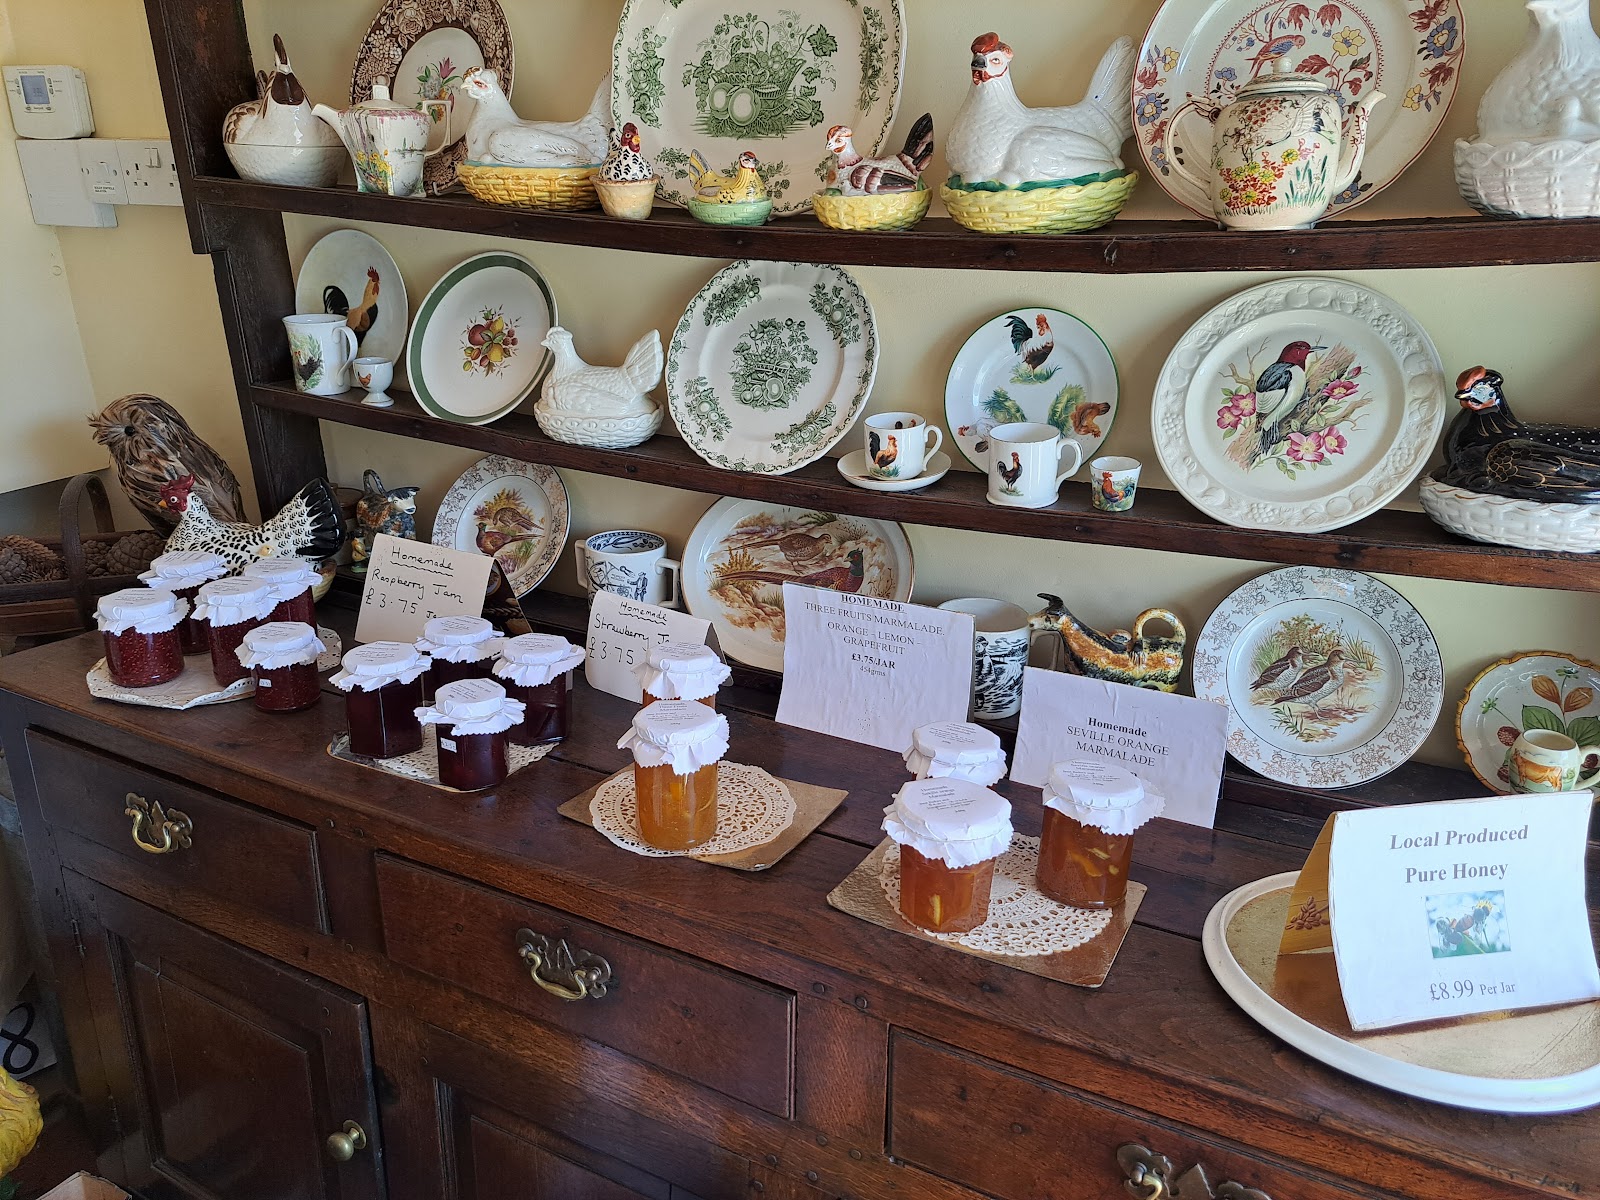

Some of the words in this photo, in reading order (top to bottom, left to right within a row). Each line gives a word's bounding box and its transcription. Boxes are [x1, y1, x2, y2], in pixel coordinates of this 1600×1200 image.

[391, 546, 454, 571] Homemade
[371, 568, 425, 600] Raspberry
[432, 583, 463, 603] Jam
[620, 601, 667, 622] Homemade
[804, 602, 836, 615] THREE
[837, 608, 872, 622] FRUITS
[840, 593, 905, 613] HOMEMADE
[594, 613, 650, 651] Strawberry
[827, 621, 869, 637] ORANGE
[878, 631, 915, 646] LEMON
[843, 636, 906, 655] GRAPEFRUIT
[851, 652, 897, 670] £3.75/JAR
[859, 665, 886, 677] 454grms
[1087, 716, 1148, 738] Homemade
[1066, 725, 1115, 744] SEVILLE
[1117, 736, 1170, 756] ORANGE
[1075, 741, 1156, 767] MARMALADE
[1389, 831, 1440, 850] Local
[1444, 824, 1529, 847] Produced
[1404, 866, 1447, 884] Pure
[1452, 862, 1509, 880] Honey
[1429, 978, 1475, 1001] £8.99
[1479, 983, 1498, 996] Per
[1500, 981, 1516, 994] Jar
